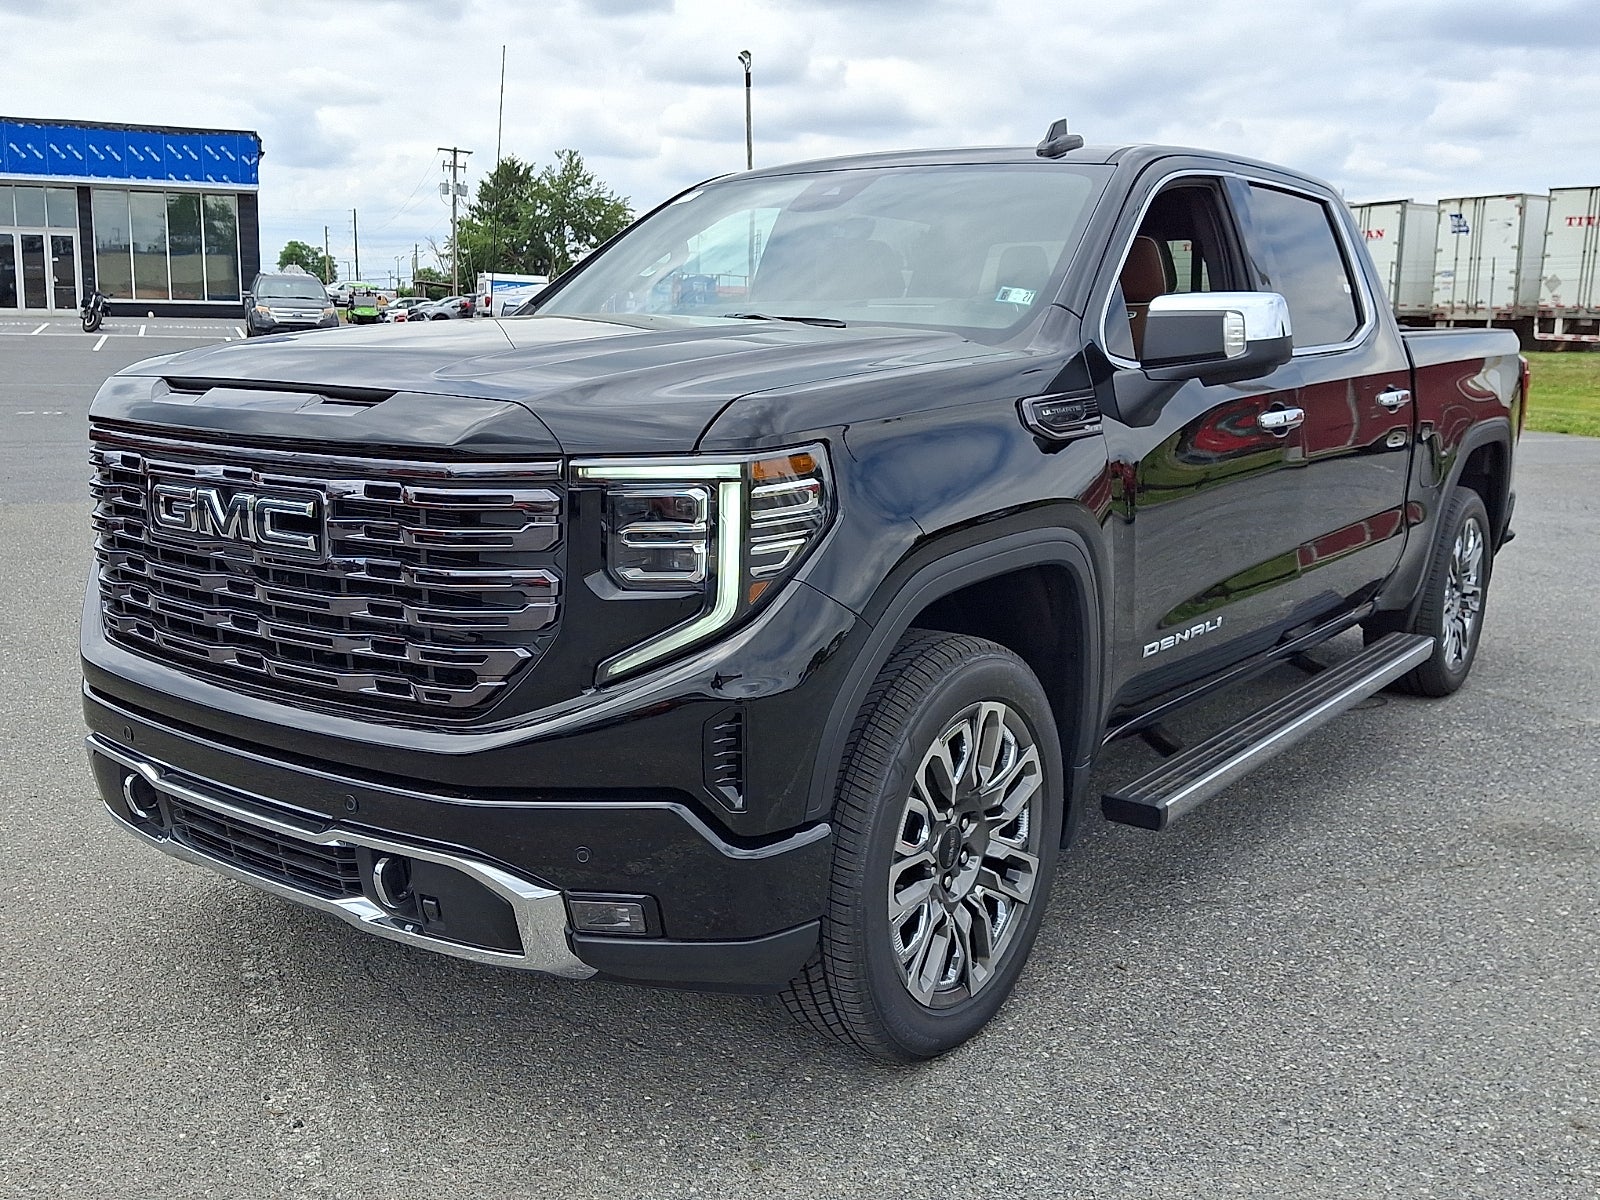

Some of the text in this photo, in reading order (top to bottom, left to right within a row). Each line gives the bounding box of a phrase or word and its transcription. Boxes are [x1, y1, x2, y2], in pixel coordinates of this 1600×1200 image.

[1565, 215, 1600, 227] TIT
[1041, 405, 1081, 416] ULTIMATE
[152, 484, 317, 552] GMC
[1142, 615, 1224, 659] DENALI
